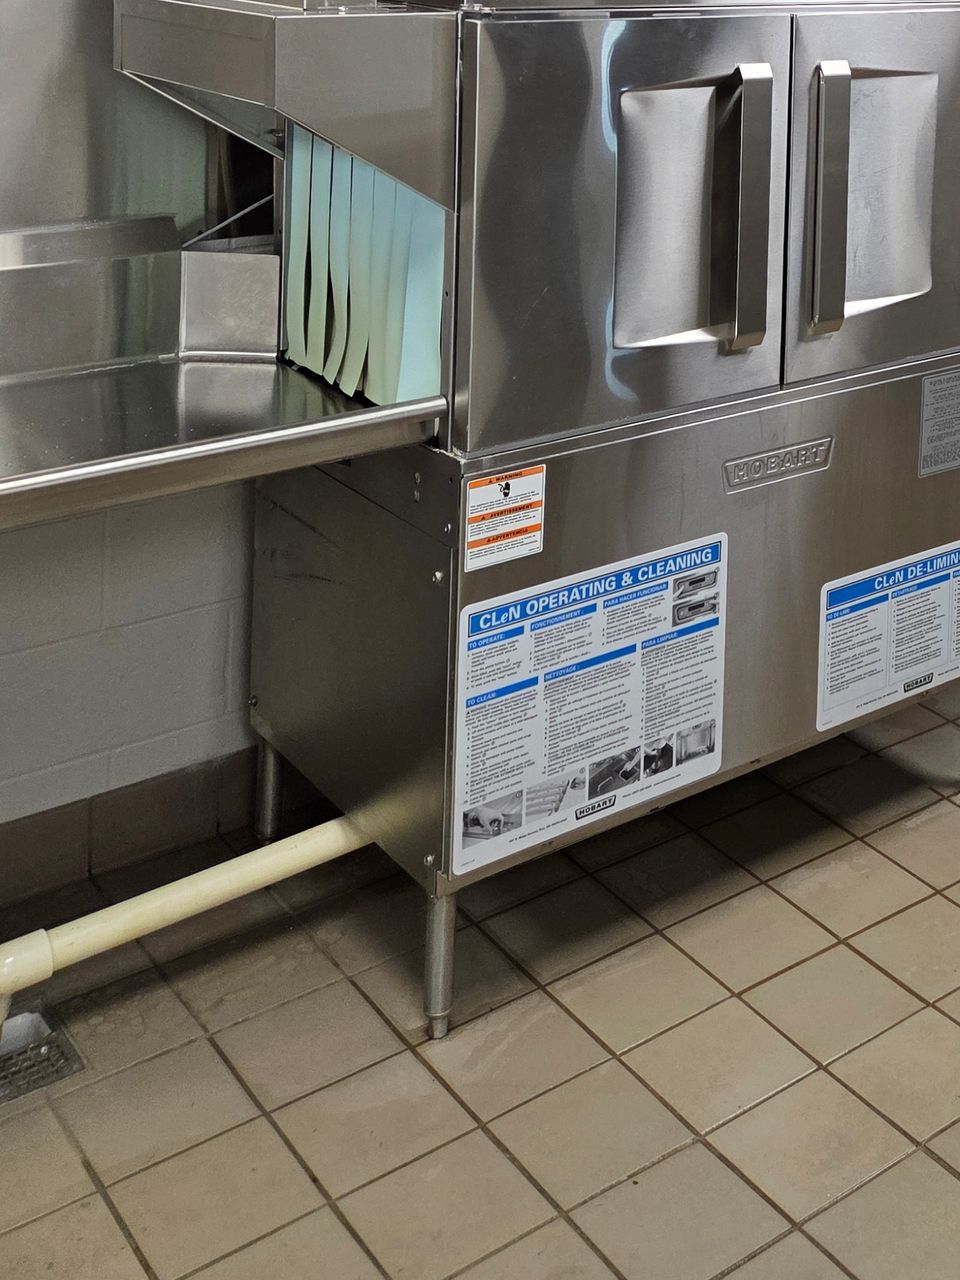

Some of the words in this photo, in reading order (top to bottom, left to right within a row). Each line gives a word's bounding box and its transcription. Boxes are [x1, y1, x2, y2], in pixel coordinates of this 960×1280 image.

[733, 446, 828, 482] HOBART
[496, 471, 523, 481] WARNING
[490, 503, 533, 518] AVERTISSEMENT
[492, 528, 528, 541] ADVERTENCIA
[874, 569, 904, 590] CLeN
[479, 605, 521, 629] CLeN
[526, 576, 617, 615] OPERATING
[621, 571, 633, 587] &
[638, 548, 712, 581] CLEANING
[604, 597, 619, 607] PARA
[619, 592, 637, 604] HACER
[642, 638, 657, 648] PARA
[905, 675, 931, 689] HOBART
[578, 797, 614, 817] HOBART
